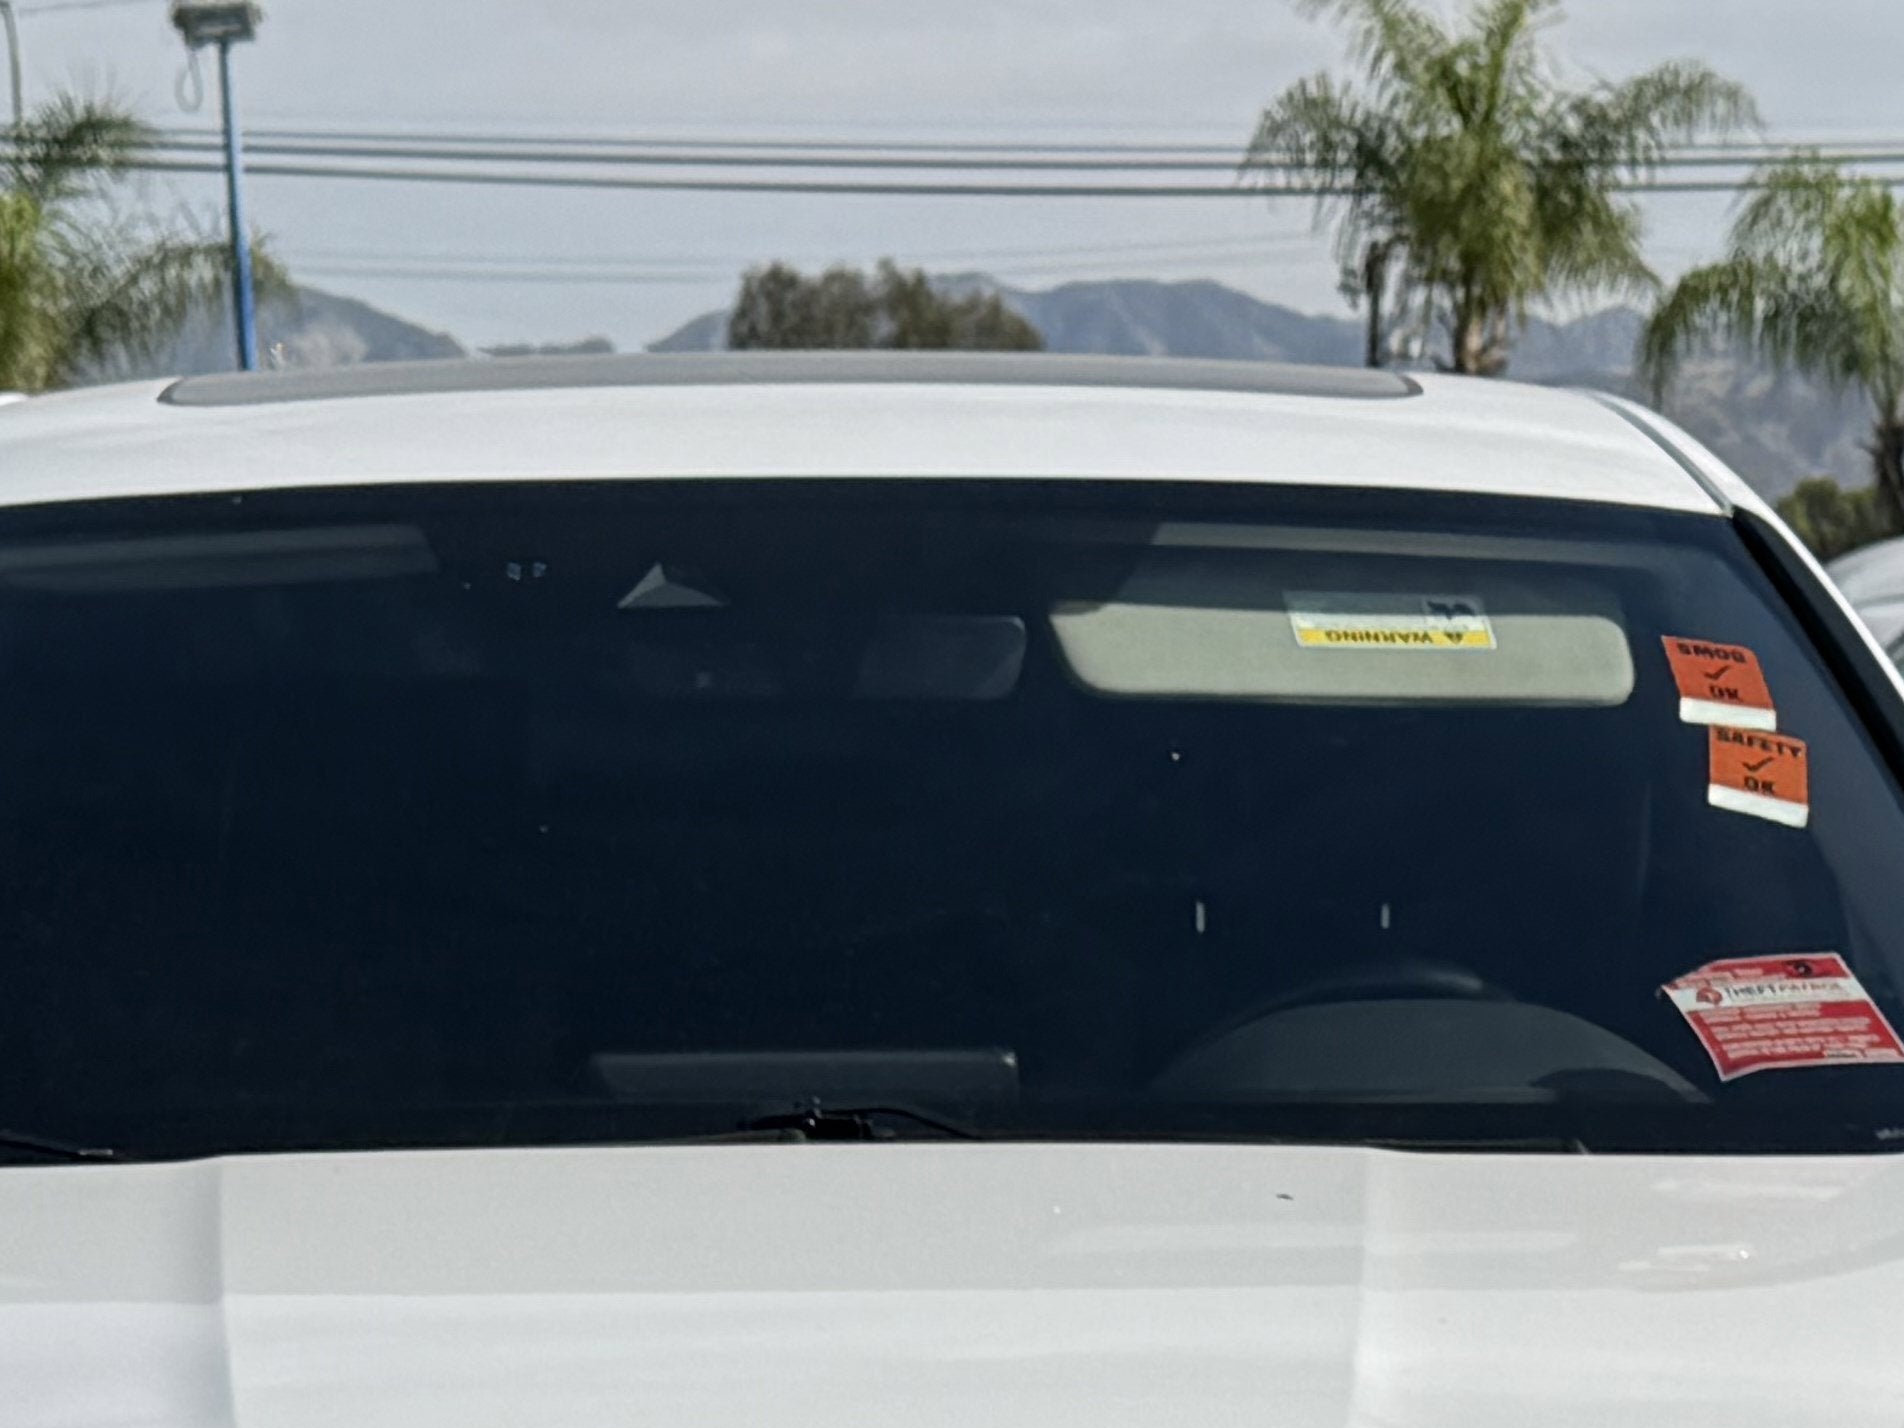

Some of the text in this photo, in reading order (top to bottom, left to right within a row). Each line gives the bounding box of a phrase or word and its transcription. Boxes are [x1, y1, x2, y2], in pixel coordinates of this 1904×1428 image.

[1677, 643, 1746, 663] SMOG
[1709, 685, 1740, 700] OK
[1717, 728, 1802, 758] SAFETY
[1743, 775, 1776, 796] OK
